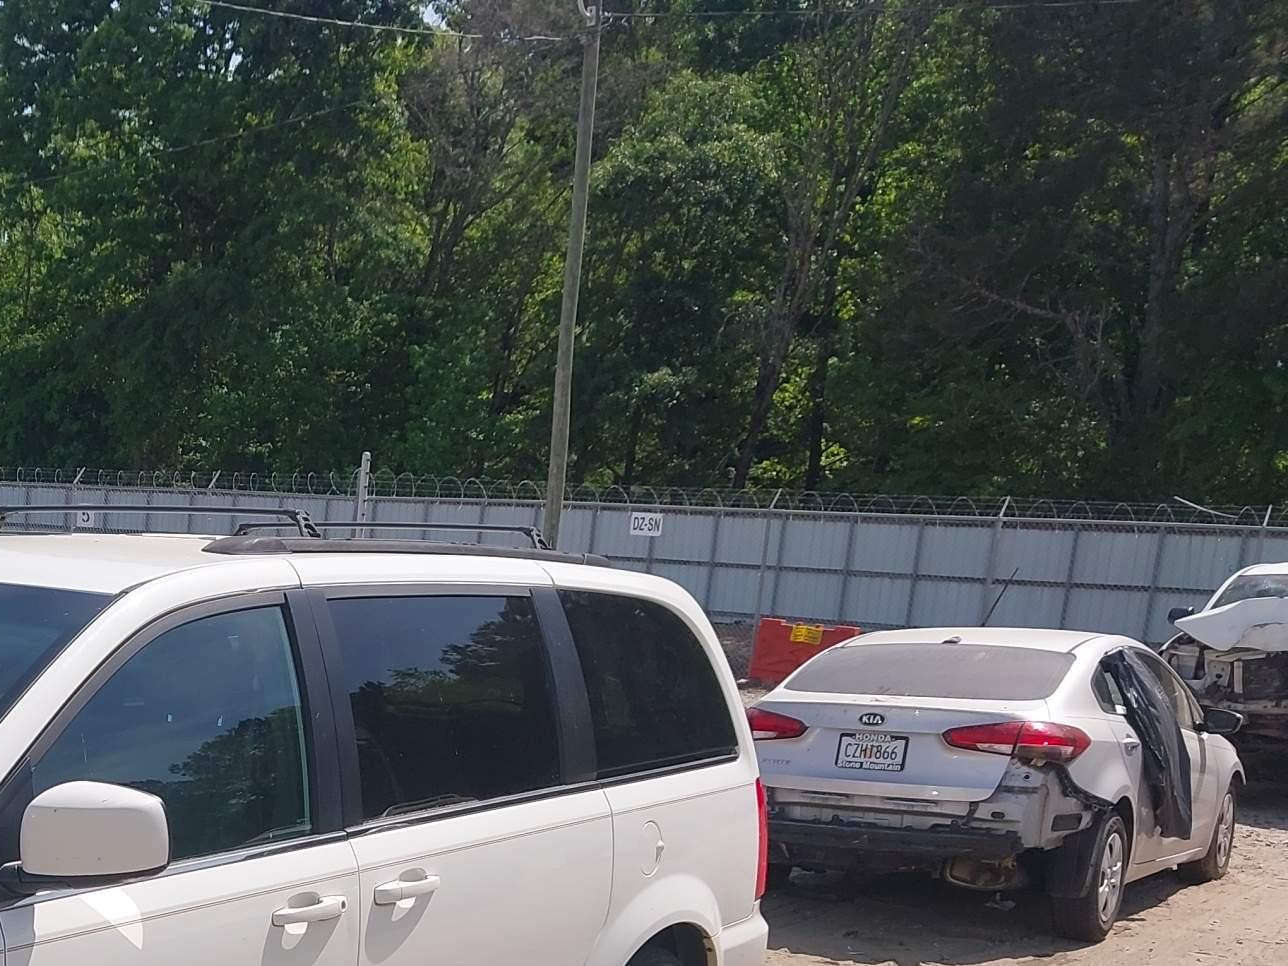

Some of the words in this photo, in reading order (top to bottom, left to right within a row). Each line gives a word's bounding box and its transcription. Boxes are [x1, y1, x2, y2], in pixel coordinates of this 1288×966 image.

[632, 516, 661, 532] DZ-SN
[862, 715, 882, 724] KIA
[855, 733, 892, 743] HONDA
[838, 760, 861, 769] Stone
[862, 761, 901, 771] Mountain
